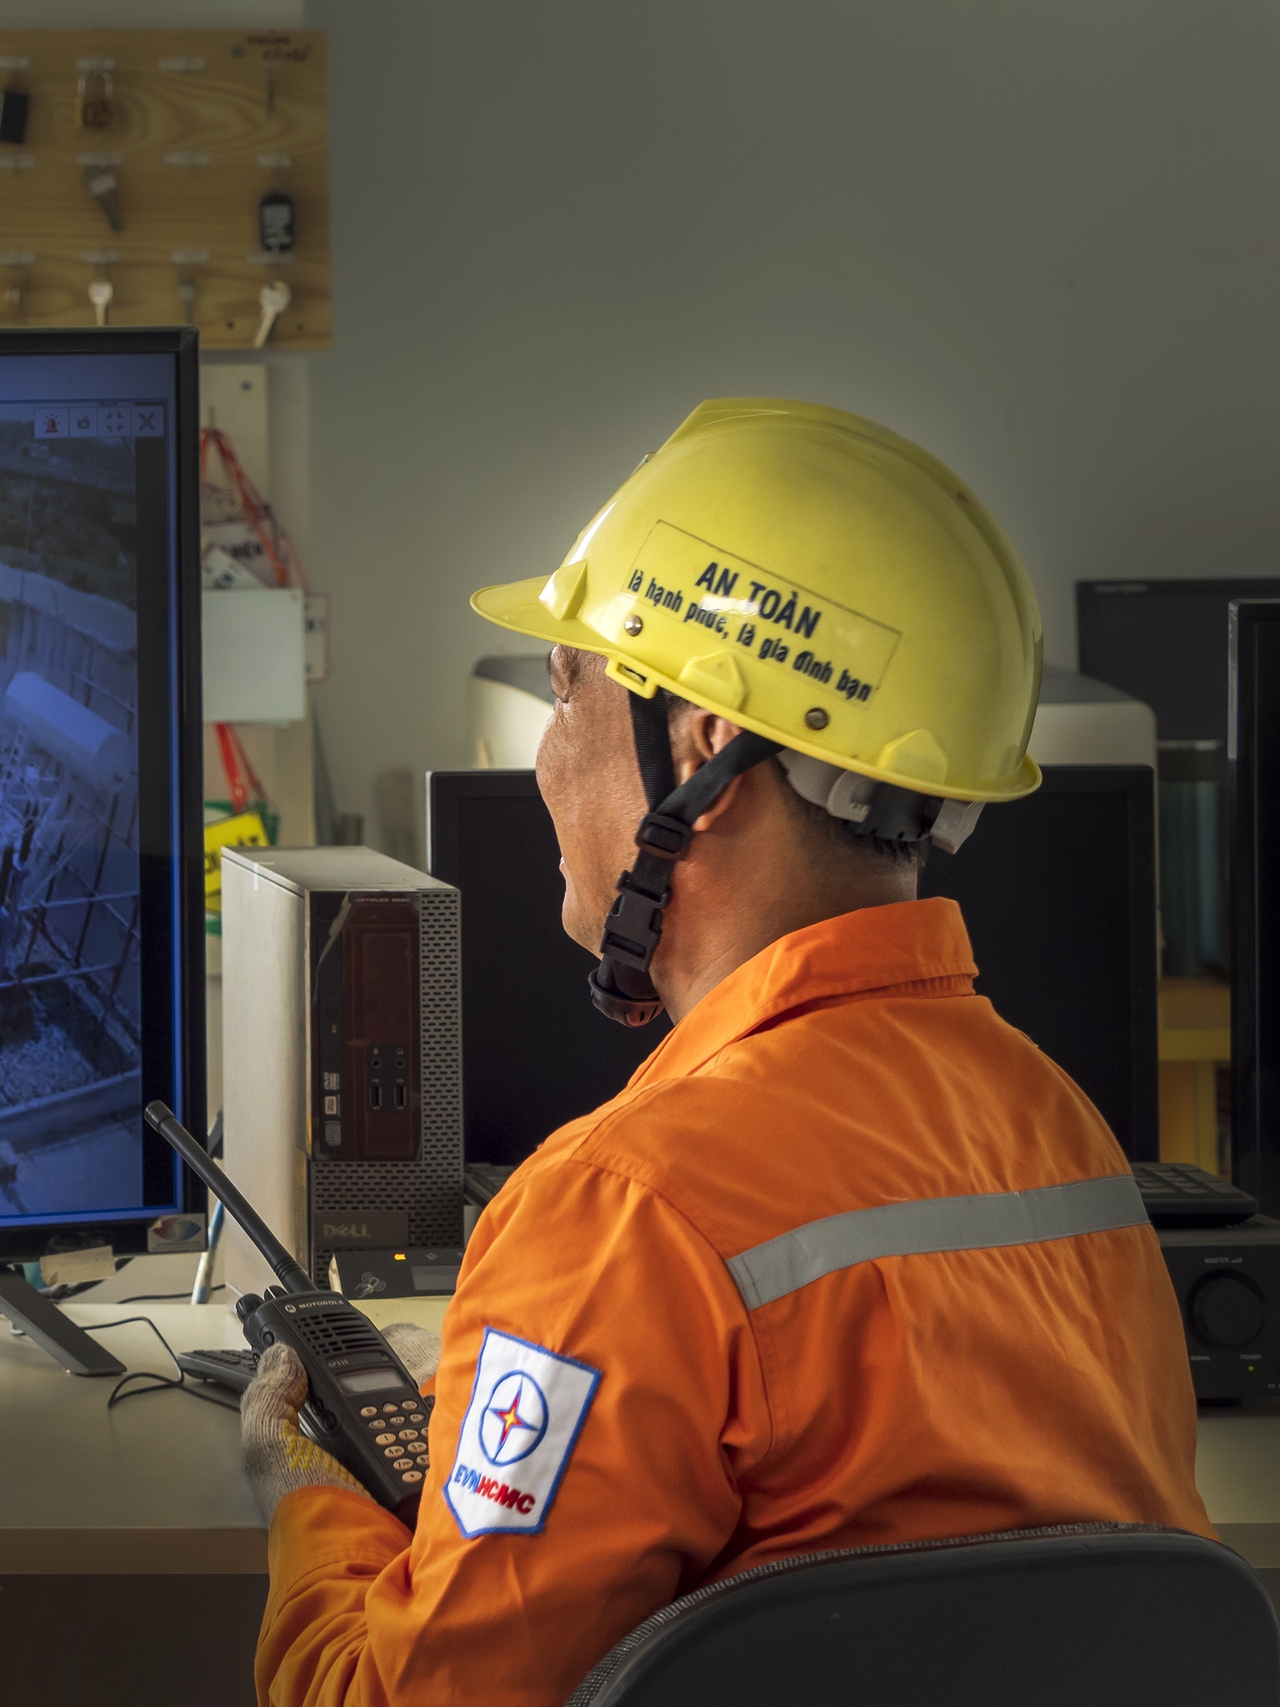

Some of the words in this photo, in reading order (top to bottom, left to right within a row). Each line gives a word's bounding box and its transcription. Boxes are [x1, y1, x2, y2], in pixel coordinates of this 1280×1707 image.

[694, 561, 740, 597] AN
[745, 579, 823, 640] TOÀN
[627, 568, 644, 593] là
[644, 577, 683, 613] hạnh
[736, 621, 756, 648] là
[757, 637, 790, 664] gia
[835, 668, 873, 703] bạn
[323, 1223, 371, 1238] DELL
[298, 1299, 345, 1310] MOTOROLA
